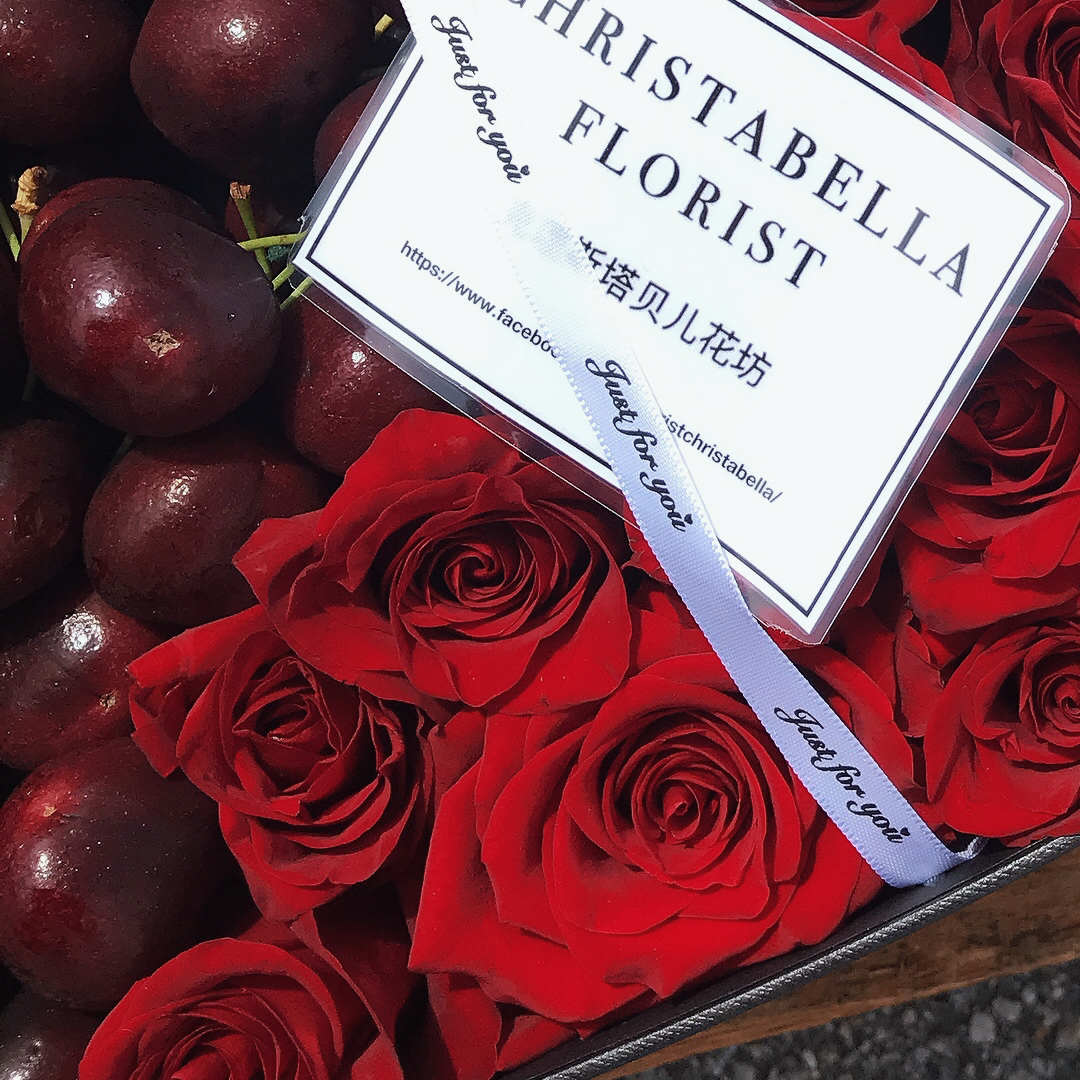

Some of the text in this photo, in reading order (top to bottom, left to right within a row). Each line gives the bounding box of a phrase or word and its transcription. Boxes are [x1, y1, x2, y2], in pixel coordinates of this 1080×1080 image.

[430, 15, 530, 184] Just for you
[558, 100, 828, 290] FLORIST
[585, 357, 693, 532] Just for you
[662, 412, 783, 503] istchristabella/
[773, 706, 911, 844] Just for you
